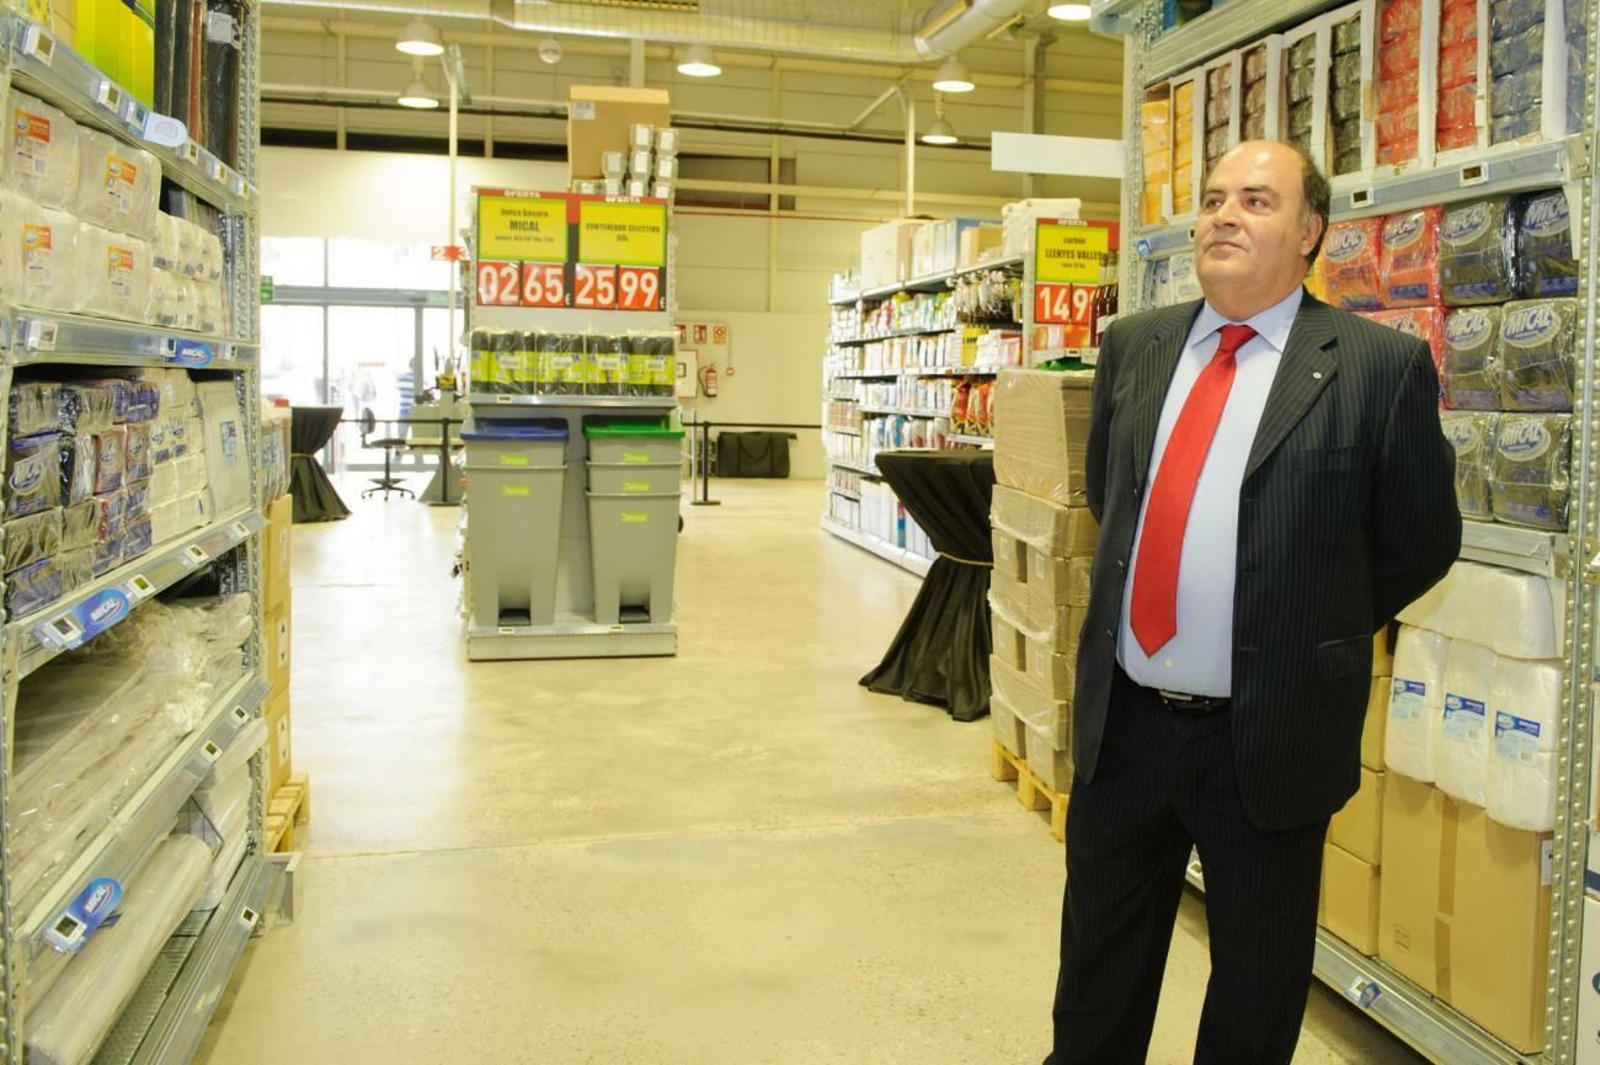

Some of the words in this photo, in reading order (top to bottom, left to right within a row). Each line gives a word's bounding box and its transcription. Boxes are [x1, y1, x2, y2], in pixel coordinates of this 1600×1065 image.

[503, 188, 541, 198] OFERTA
[509, 219, 539, 232] MICAL
[1504, 302, 1555, 338] MICAL
[1498, 420, 1546, 450] MICAL
[90, 598, 119, 621] MICAL
